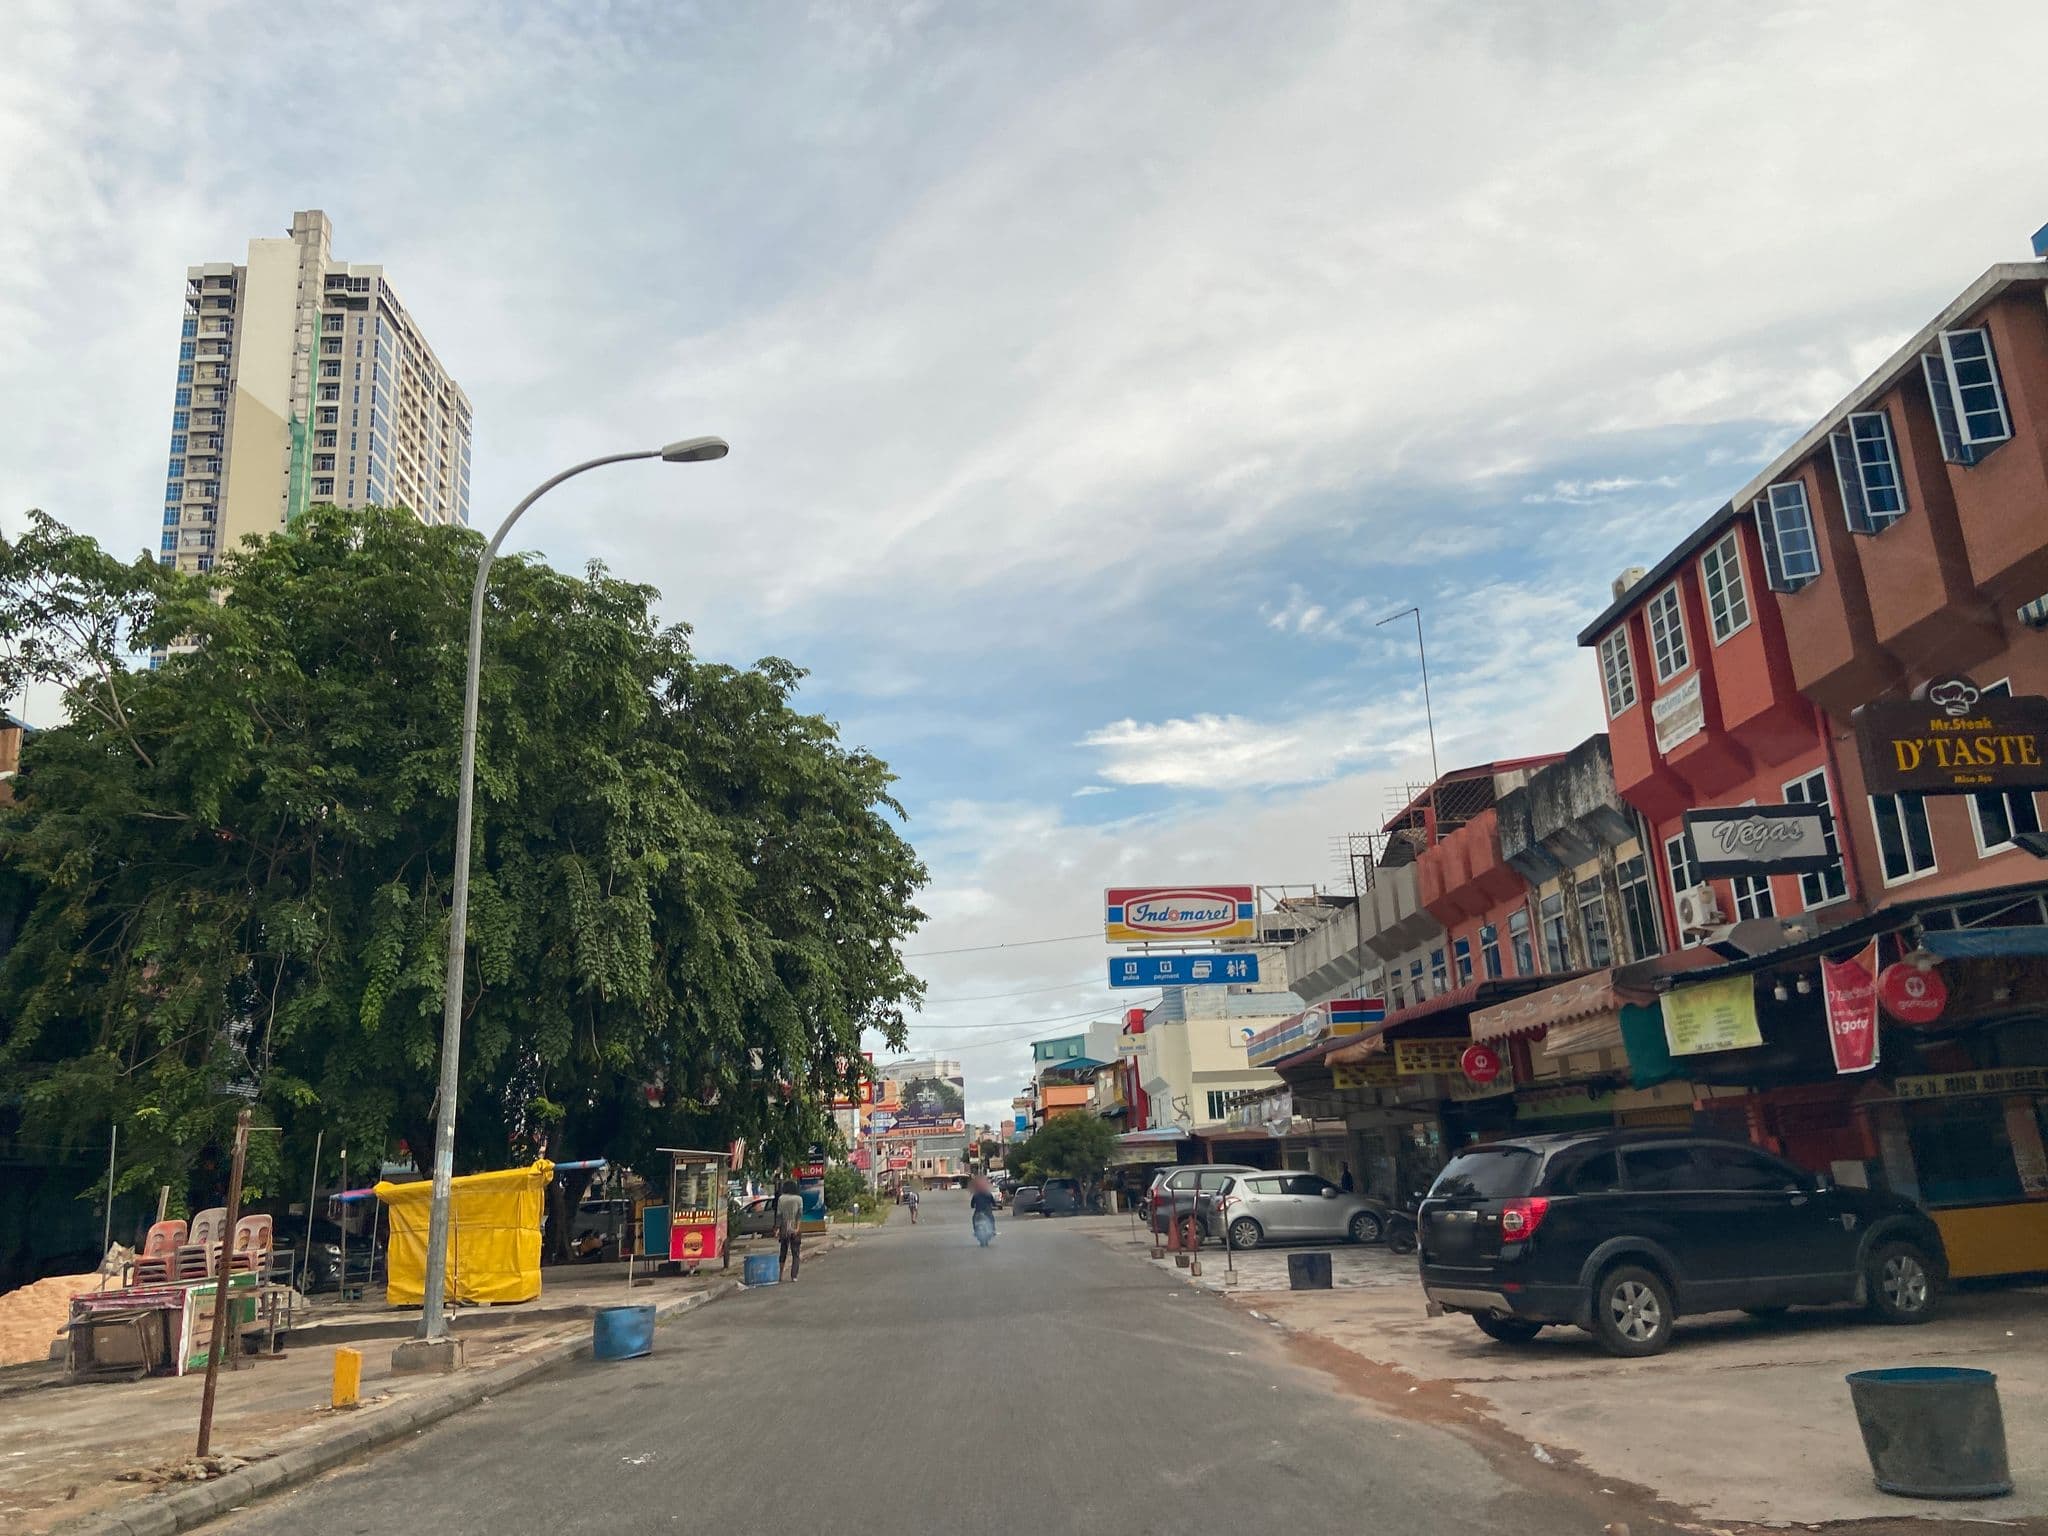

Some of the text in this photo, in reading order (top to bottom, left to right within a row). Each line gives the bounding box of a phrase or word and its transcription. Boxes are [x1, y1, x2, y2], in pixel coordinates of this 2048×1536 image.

[1892, 735, 2041, 772] D'TASTE
[1712, 820, 1804, 854] Vegas
[1132, 903, 1229, 922] Indomaret
